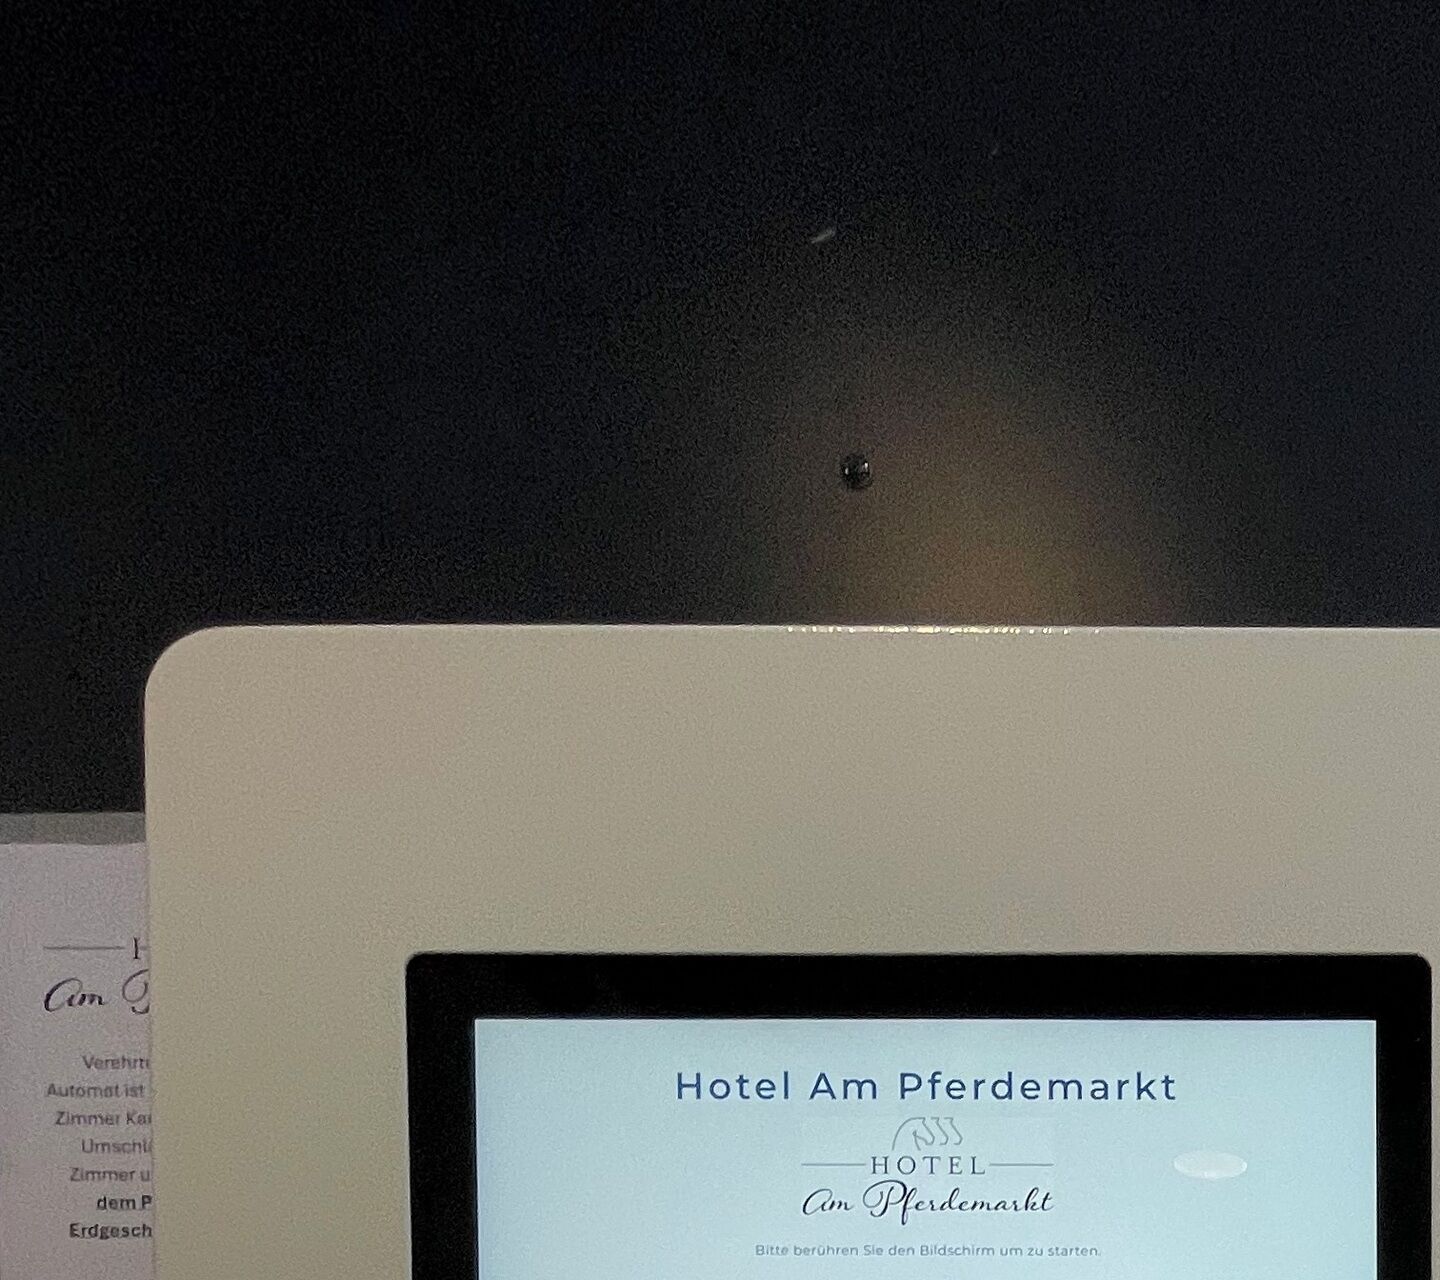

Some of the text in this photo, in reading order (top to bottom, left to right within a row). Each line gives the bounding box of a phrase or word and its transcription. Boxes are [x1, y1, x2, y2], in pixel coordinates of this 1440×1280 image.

[47, 1083, 145, 1098] Automat ist
[676, 1071, 1177, 1101] Hotel Am Pferdemarkt
[55, 1111, 119, 1125] Zimmer
[870, 1156, 986, 1176] HOTEL
[70, 1167, 135, 1182] Zimmer
[97, 1196, 136, 1210] dem
[862, 1179, 1055, 1226] Pferdemarkt
[69, 1223, 152, 1240] Erdgesch
[755, 1244, 789, 1257] Bitte
[863, 1244, 884, 1257] Sie
[888, 1244, 915, 1257] den
[920, 1244, 995, 1257] Bildschirm
[1000, 1246, 1023, 1257] um
[1027, 1246, 1043, 1257] zu
[1047, 1245, 1101, 1257] starten.
